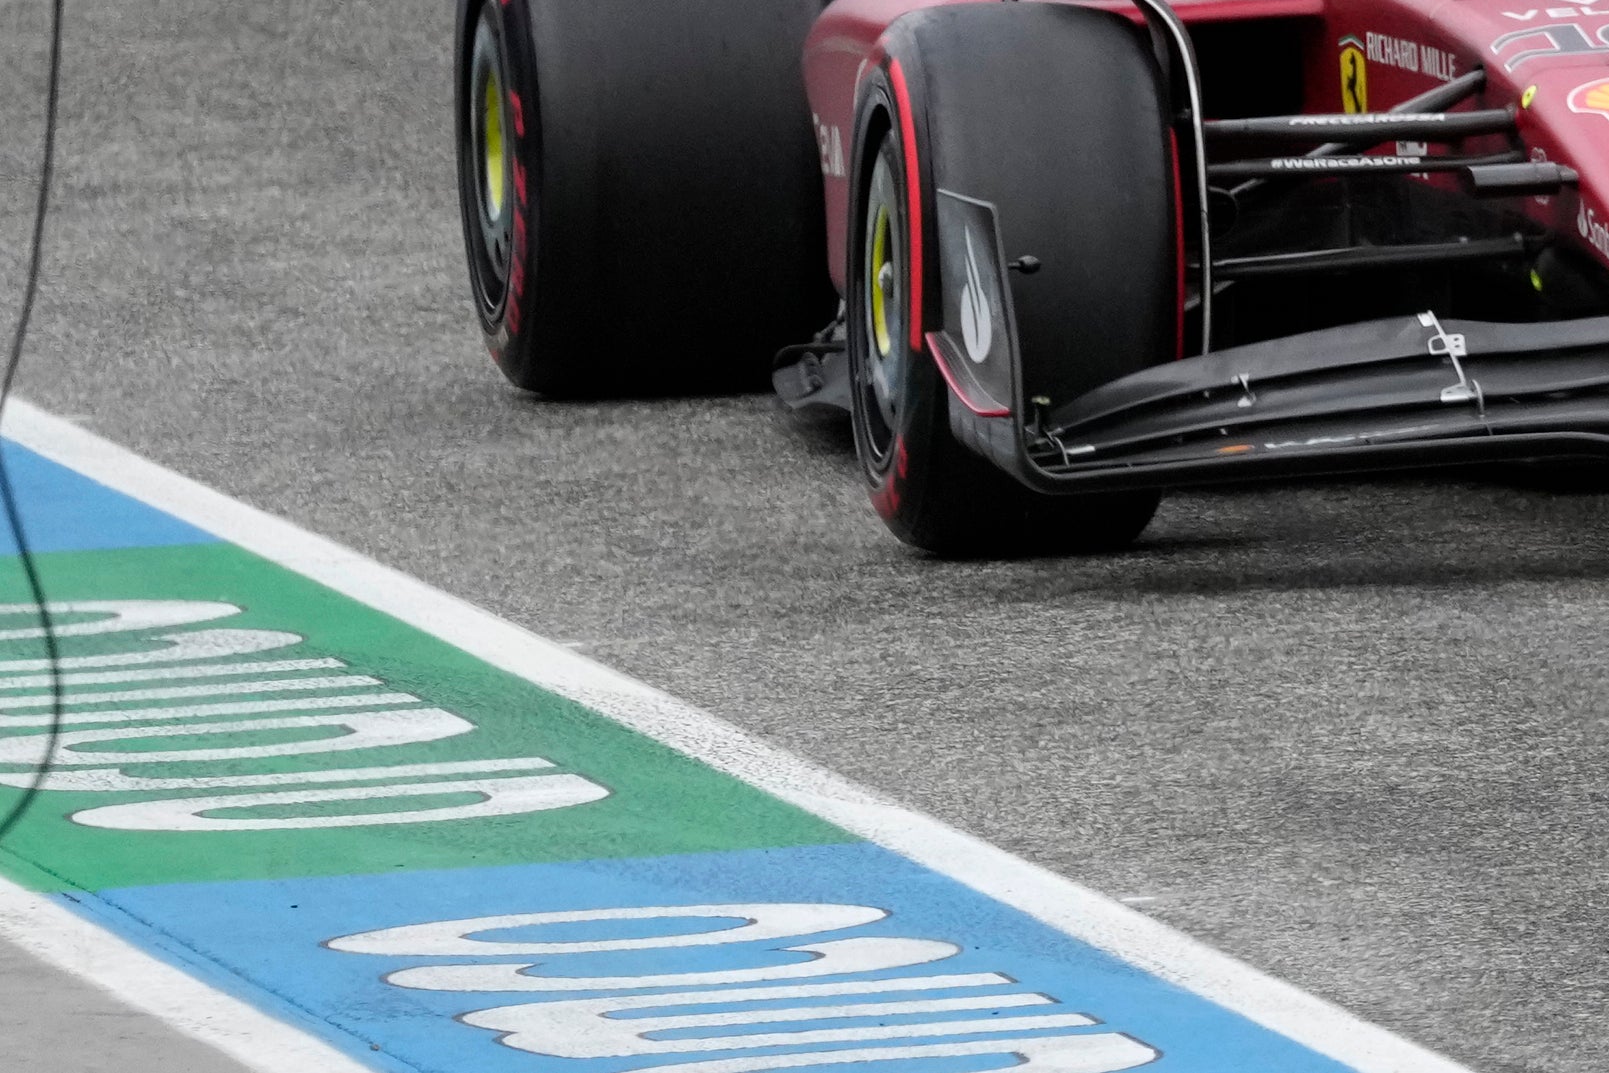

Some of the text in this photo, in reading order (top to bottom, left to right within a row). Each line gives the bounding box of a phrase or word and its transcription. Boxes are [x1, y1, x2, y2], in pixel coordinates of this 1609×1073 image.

[1366, 31, 1457, 81] RICHARD MILLE
[1271, 156, 1421, 170] #WeRaceAsOne
